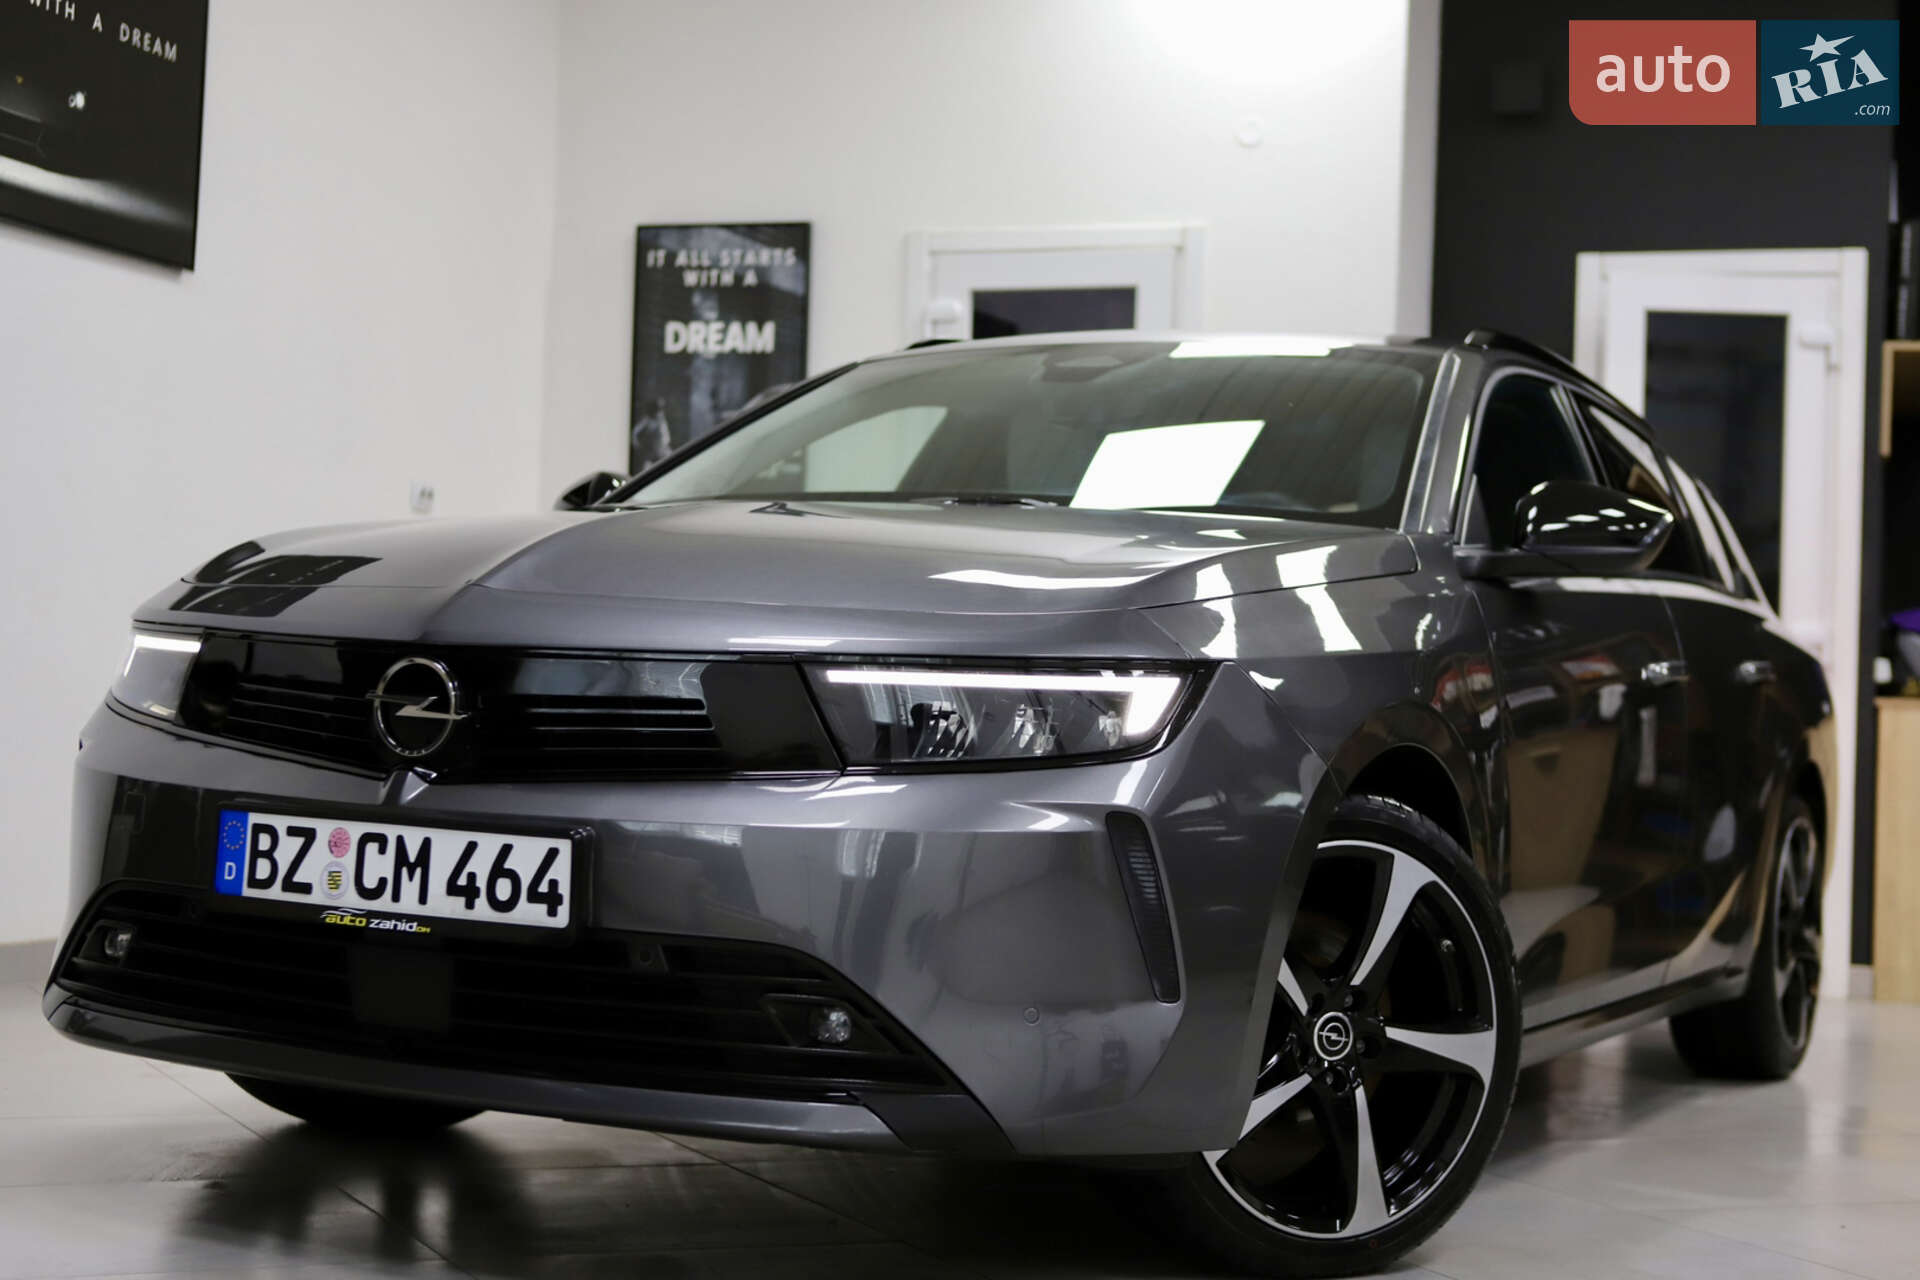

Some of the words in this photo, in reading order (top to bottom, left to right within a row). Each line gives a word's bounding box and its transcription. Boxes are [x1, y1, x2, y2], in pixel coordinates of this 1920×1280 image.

[92, 12, 103, 32] A
[119, 22, 178, 62] DREAM
[646, 250, 667, 268] IT
[675, 249, 712, 267] ALL
[719, 248, 798, 267] STARTS
[682, 270, 735, 287] WITH
[743, 270, 759, 287] A
[663, 320, 776, 354] DREAM
[224, 861, 237, 881] D
[247, 822, 317, 895] BZ
[354, 831, 432, 906] CM
[446, 840, 564, 918] 464
